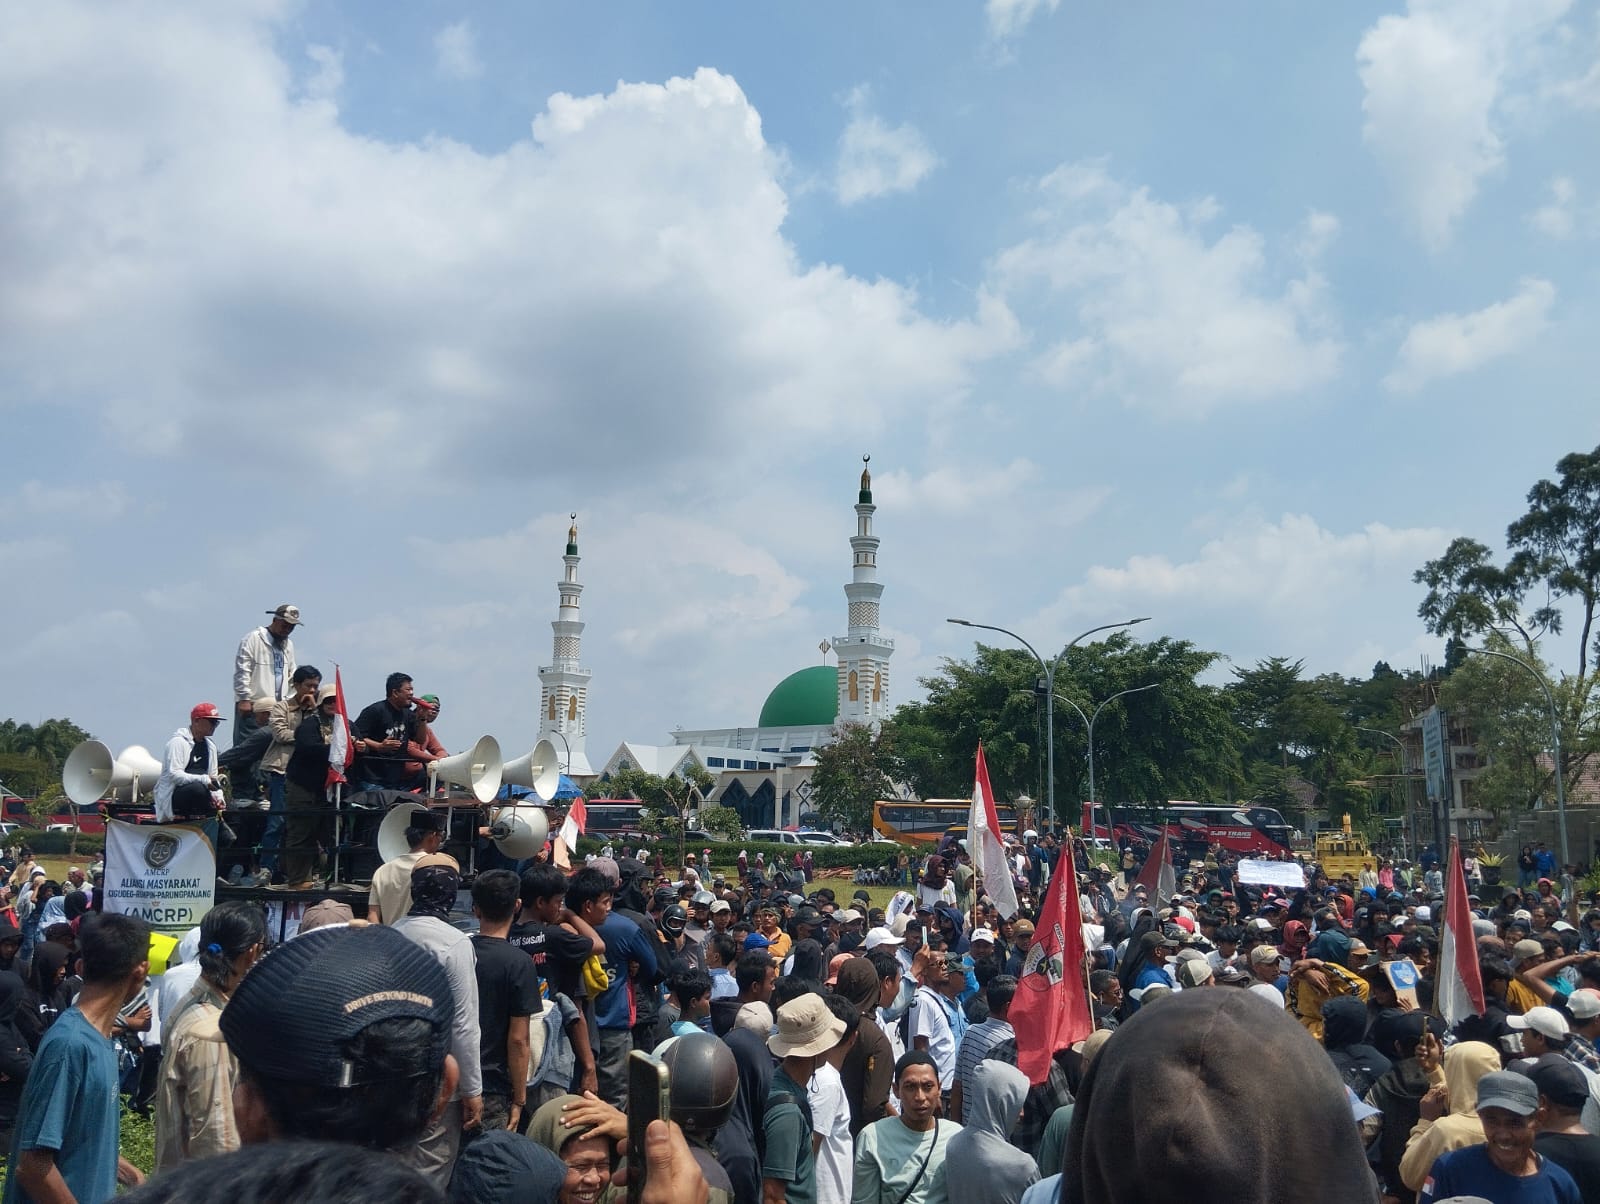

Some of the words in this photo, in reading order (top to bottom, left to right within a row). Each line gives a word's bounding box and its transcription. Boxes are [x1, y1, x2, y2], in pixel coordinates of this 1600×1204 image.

[144, 868, 170, 876] AMCRP
[121, 878, 145, 889] ALIANSI
[147, 878, 200, 889] MASYARAKAT
[124, 906, 193, 922] (AMCRP)
[522, 932, 545, 946] susah
[344, 996, 373, 1013] DRIVE
[373, 991, 407, 1001] BEYOND
[408, 993, 433, 1007] LIMITS
